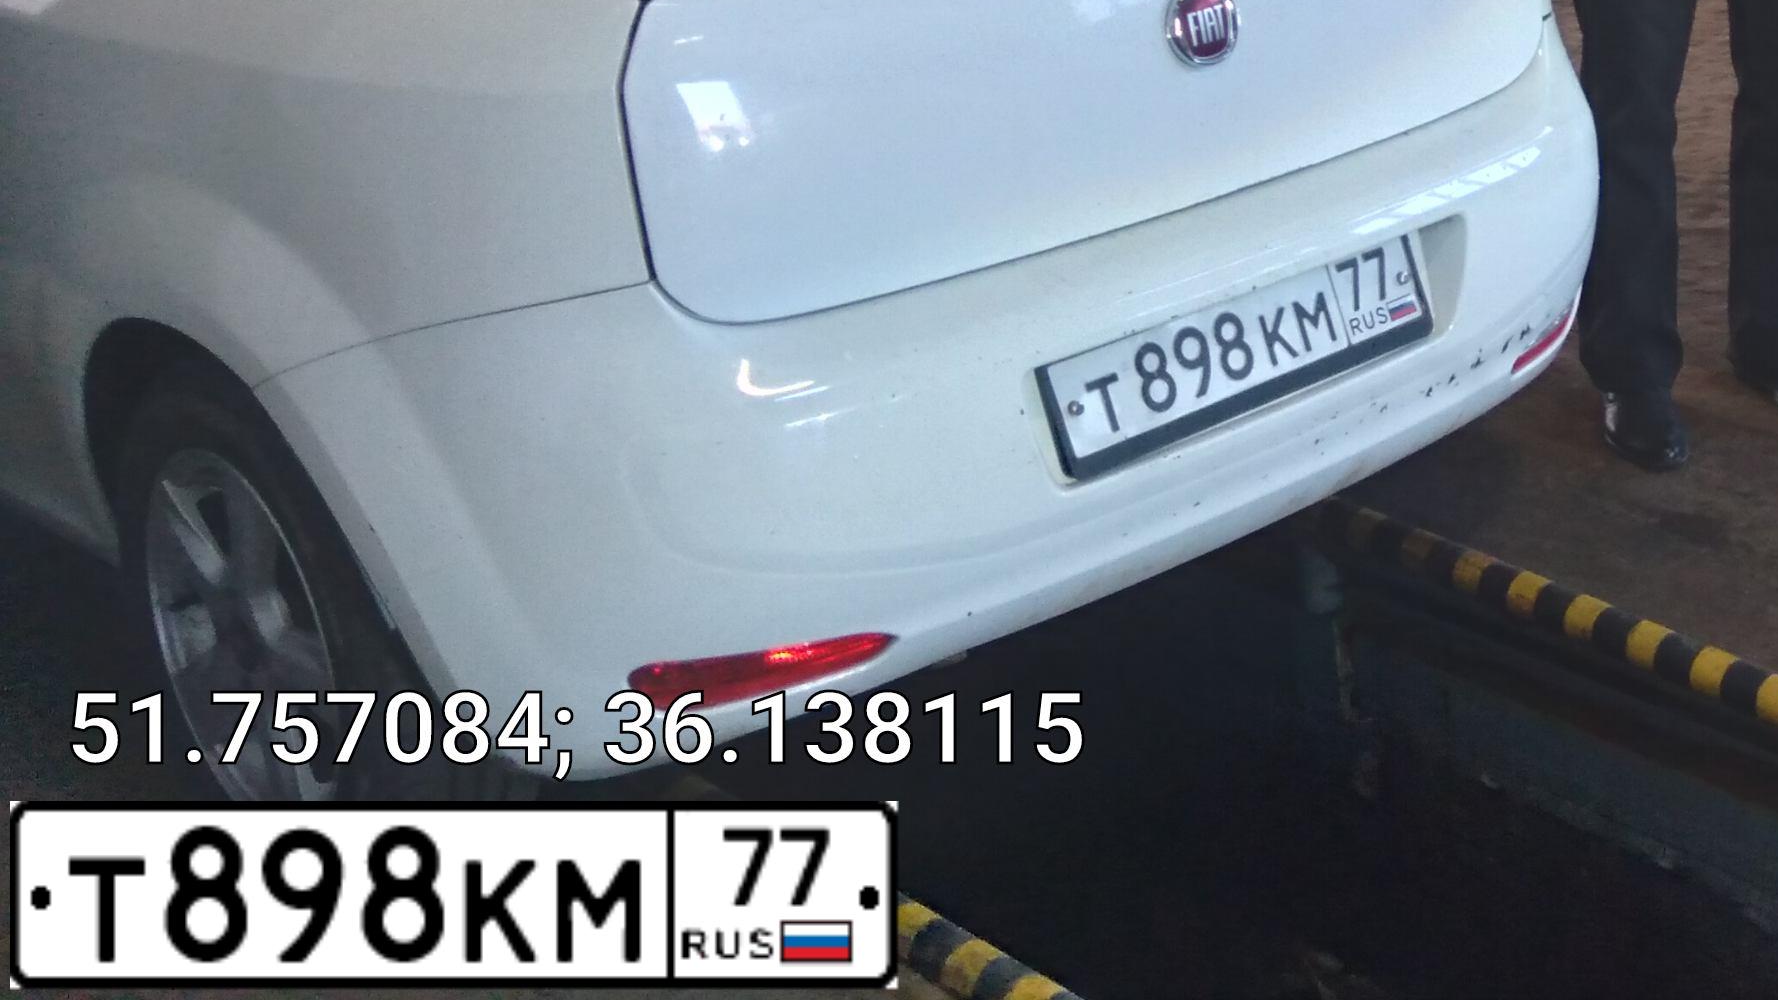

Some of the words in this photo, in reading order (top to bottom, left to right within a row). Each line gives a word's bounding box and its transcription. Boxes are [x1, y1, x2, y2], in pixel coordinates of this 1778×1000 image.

[1186, 3, 1225, 47] FIAT
[1335, 246, 1386, 312] 77
[1348, 305, 1388, 336] RUS
